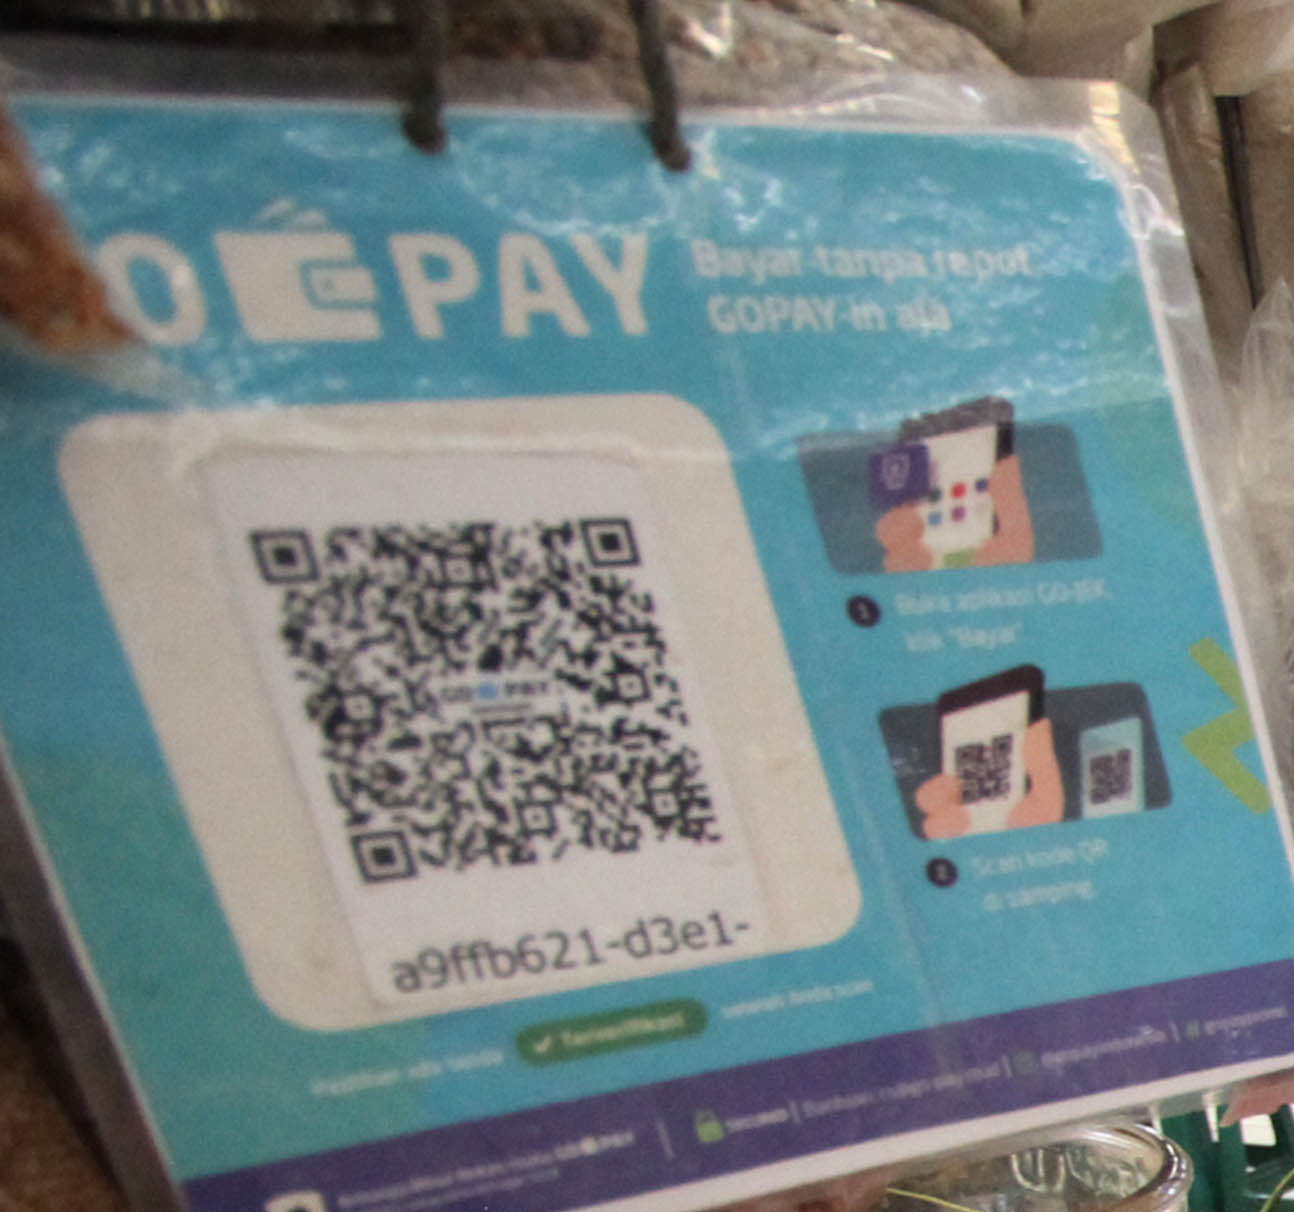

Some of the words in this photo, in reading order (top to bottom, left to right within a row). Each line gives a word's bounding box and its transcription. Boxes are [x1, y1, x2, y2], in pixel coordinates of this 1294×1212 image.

[101, 231, 206, 346] O
[389, 231, 650, 338] PAY
[392, 911, 750, 994] a9ffb621-d3e1-
